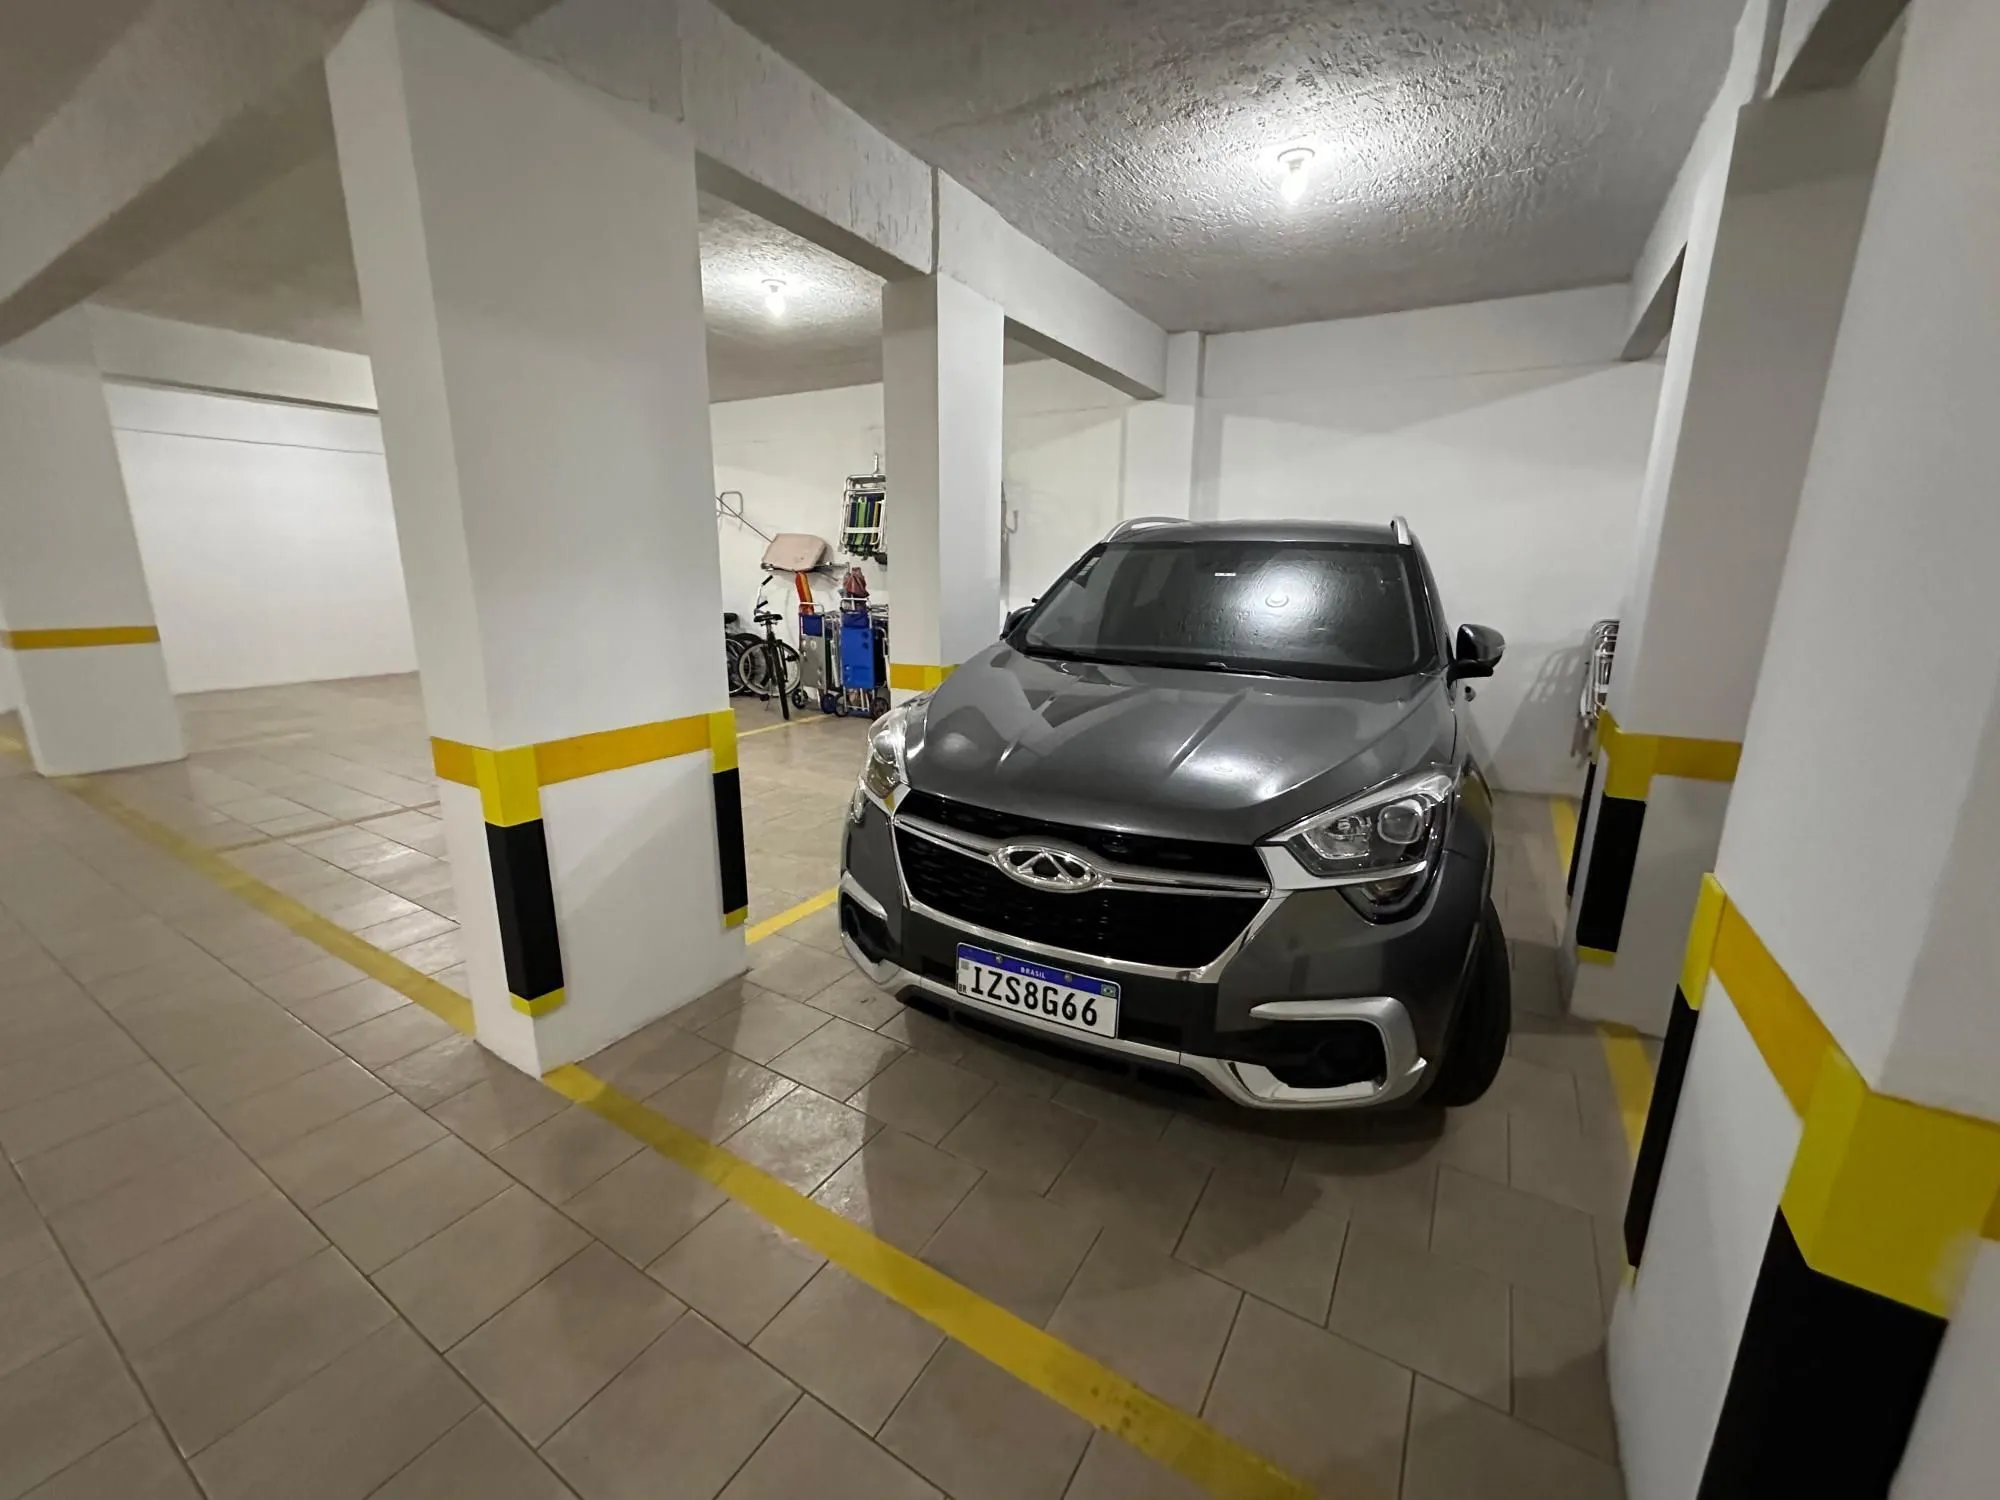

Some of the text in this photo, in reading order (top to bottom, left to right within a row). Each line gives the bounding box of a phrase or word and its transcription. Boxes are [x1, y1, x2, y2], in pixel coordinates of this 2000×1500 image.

[1020, 966, 1046, 980] BRASIL
[958, 983, 967, 994] BR
[971, 966, 1097, 1027] IZS8G66
